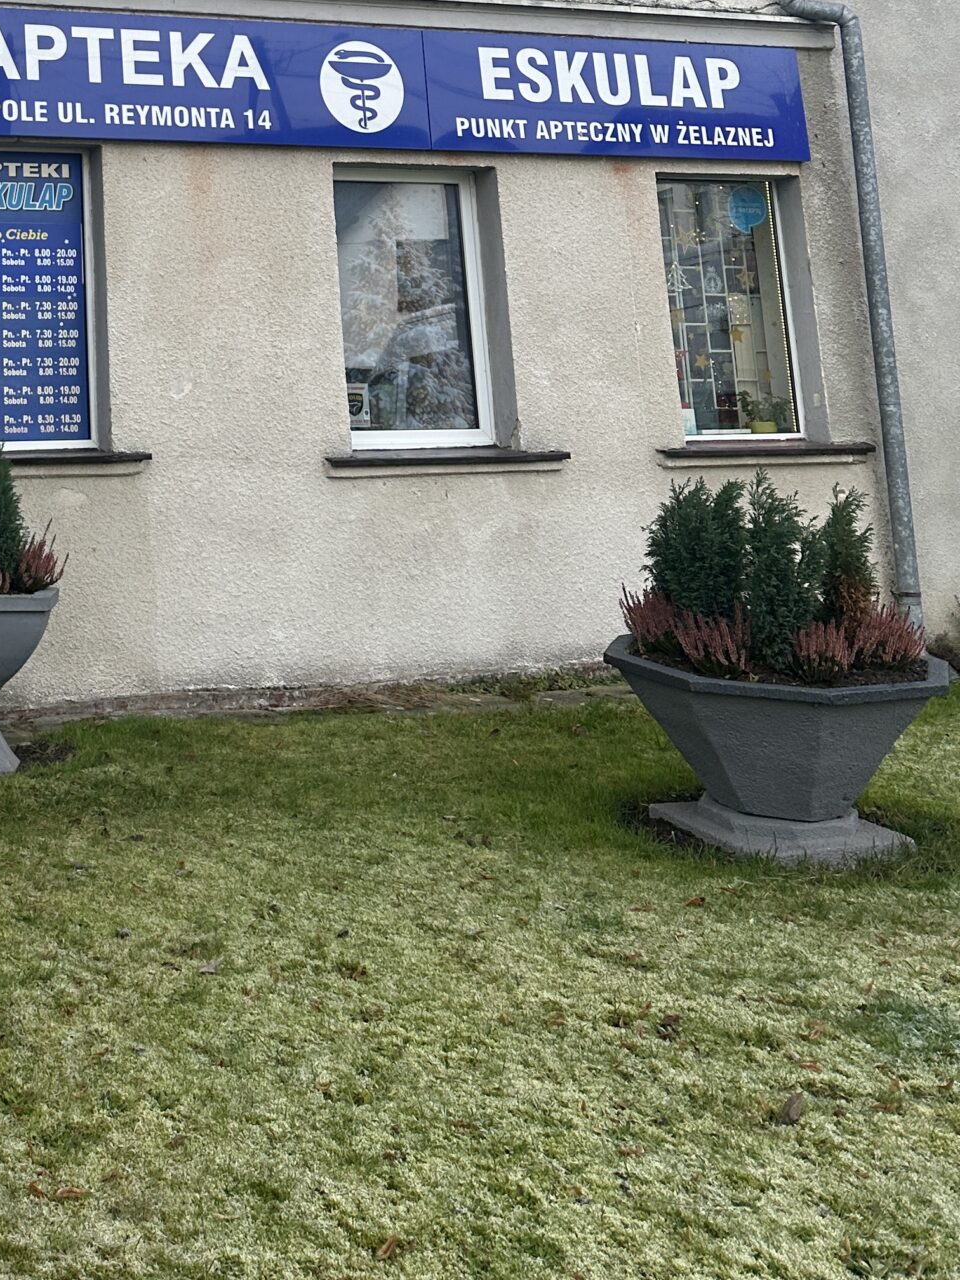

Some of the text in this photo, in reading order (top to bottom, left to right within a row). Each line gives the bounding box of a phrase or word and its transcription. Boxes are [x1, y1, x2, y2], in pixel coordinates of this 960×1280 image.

[477, 46, 741, 110] ESKULAP
[58, 102, 96, 125] UL.
[105, 104, 235, 130] REYMONTA
[243, 109, 272, 130] 14
[455, 117, 775, 148] PUNKT APTECZNY W ŻELAZNEJ
[5, 229, 49, 240] Ciebie
[35, 249, 50, 257] 8.00
[57, 249, 76, 257] 20.00
[2, 275, 77, 284] Pn. Pt. 8.00 19.00
[2, 302, 77, 310] Pn. Pt. 7.30 20.00
[3, 329, 78, 338] Pn. Pt. 7.30 20.00
[3, 358, 79, 366] Pn. Pt. 7.30 20.00
[4, 368, 26, 376] Sobota
[4, 386, 80, 395] Pn. Pt. 8.00 19.00
[40, 396, 54, 404] 8.00
[5, 414, 81, 424] Pn. Pt. 8.30 18.30
